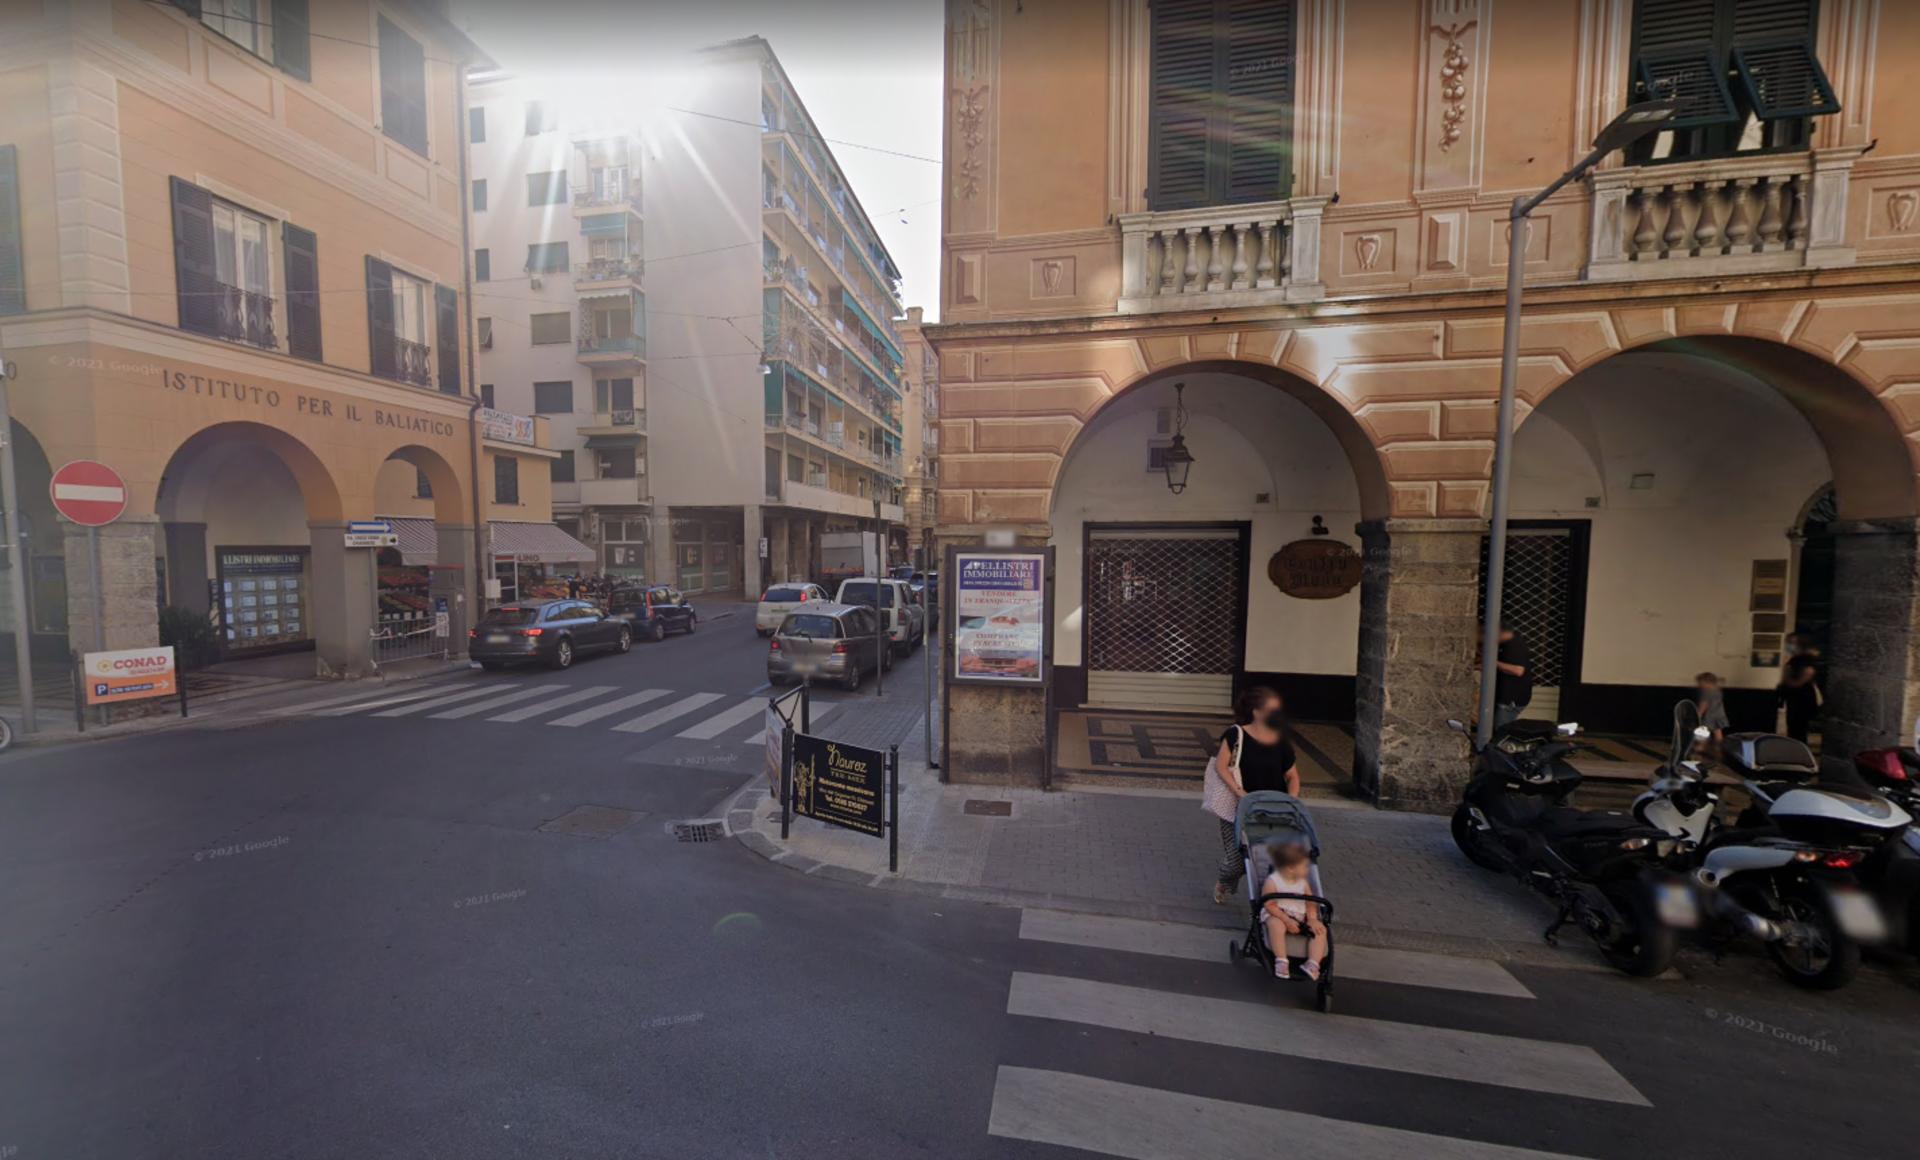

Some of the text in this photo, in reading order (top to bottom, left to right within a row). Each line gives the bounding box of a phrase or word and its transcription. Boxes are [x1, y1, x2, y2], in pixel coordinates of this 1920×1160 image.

[162, 369, 280, 408] ISTITUTO
[297, 396, 333, 417] PER
[346, 405, 361, 422] IL
[375, 410, 454, 437] BALIATICO
[963, 570, 1033, 579] IMMOBILIARE
[113, 656, 167, 670] CONAD
